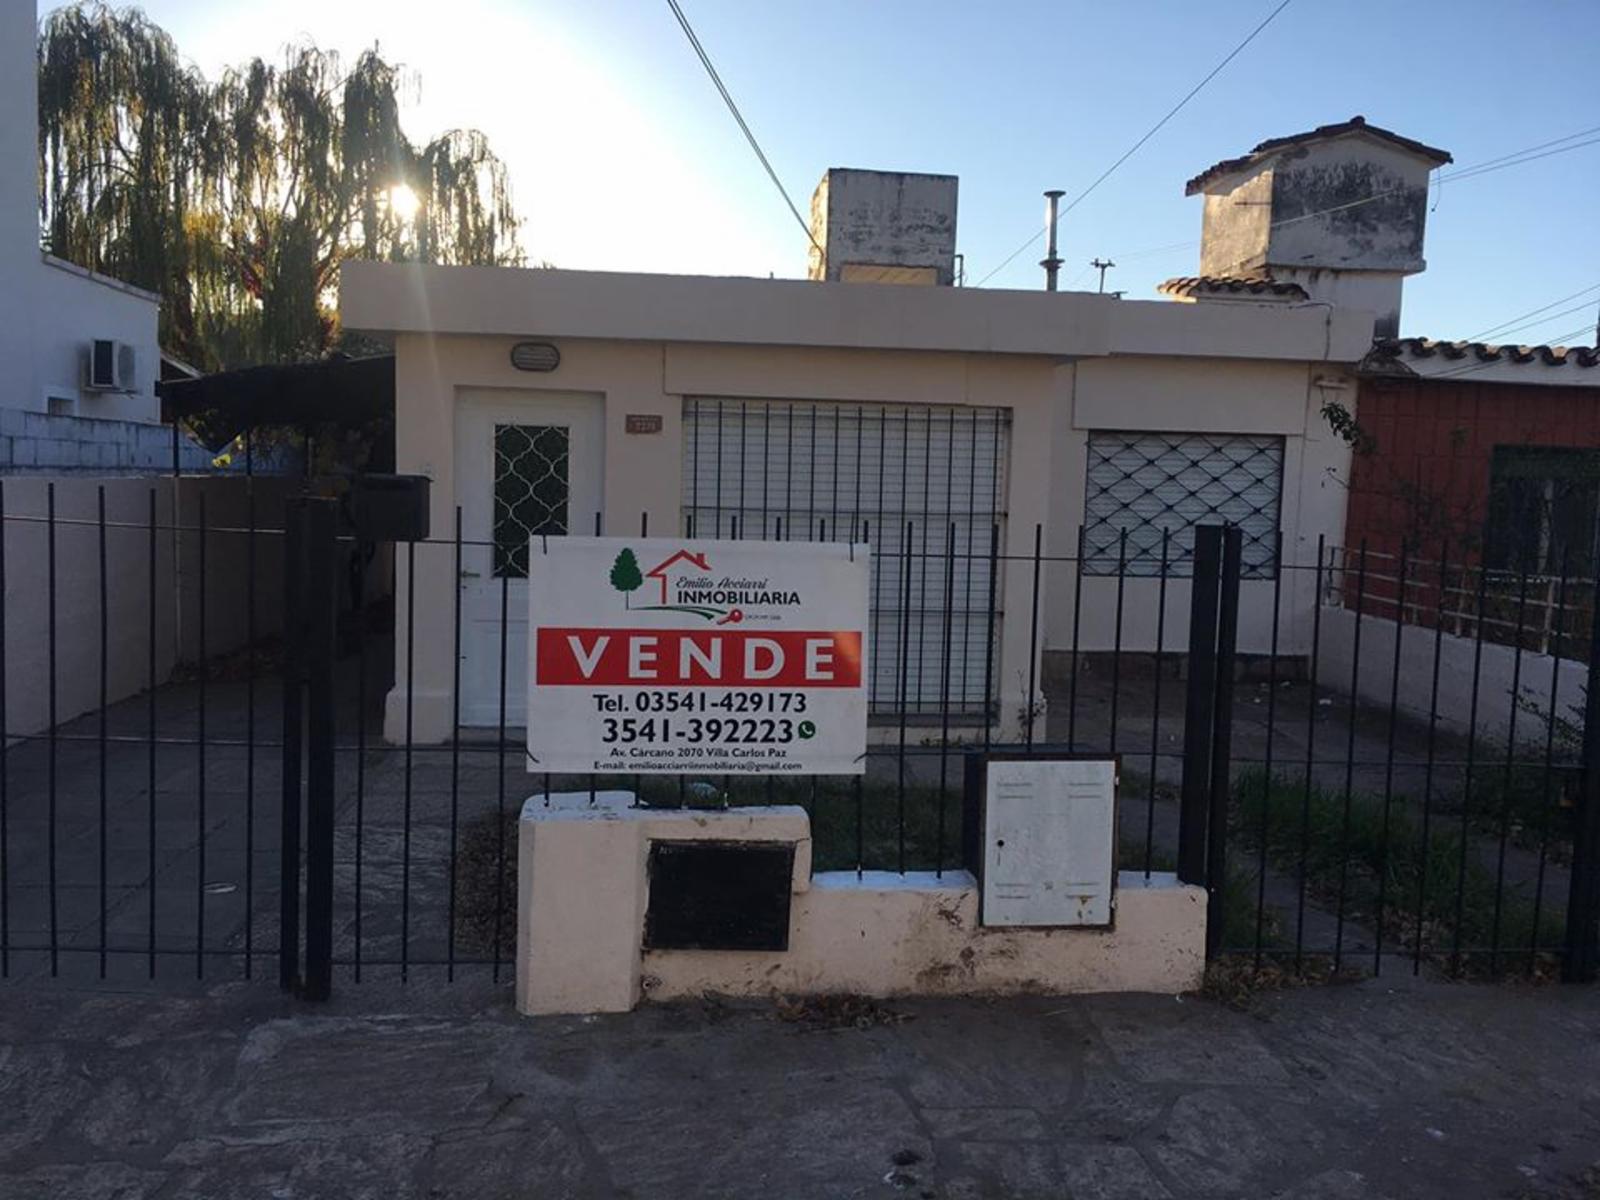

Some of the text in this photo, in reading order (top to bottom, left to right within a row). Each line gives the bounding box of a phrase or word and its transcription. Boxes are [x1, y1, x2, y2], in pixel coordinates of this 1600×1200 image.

[676, 576, 714, 589] Emilio
[677, 591, 801, 605] INMOBILIARIA
[567, 635, 834, 680] VENDE
[593, 691, 807, 713] Tel. 03541-429173
[602, 718, 793, 744] 3541-392223
[609, 747, 787, 758] Av. Cárcano 2070 Villa Carlos Paz
